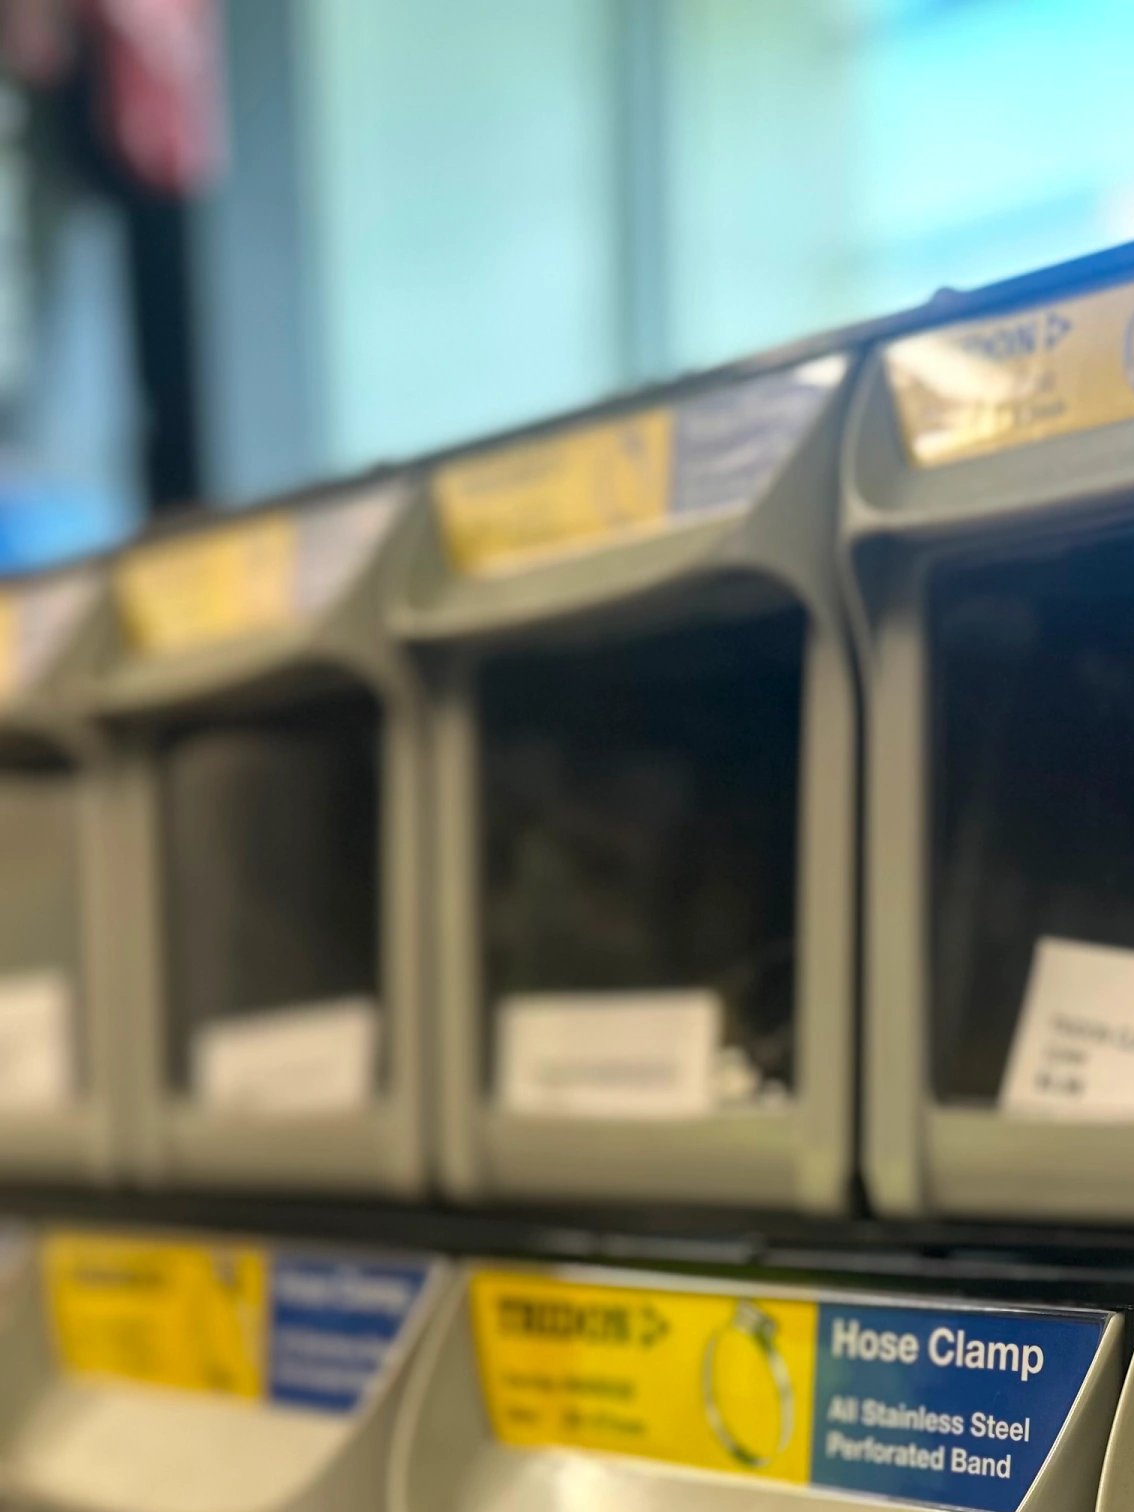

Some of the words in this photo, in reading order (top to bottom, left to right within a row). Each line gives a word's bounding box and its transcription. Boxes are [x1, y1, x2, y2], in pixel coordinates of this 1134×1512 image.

[831, 1317, 919, 1364] Hose
[928, 1327, 1044, 1382] Clamp
[827, 1395, 858, 1424] All
[861, 1398, 964, 1435] Stainless
[970, 1411, 1030, 1442] Steel
[826, 1430, 945, 1471] Perforated
[951, 1447, 1012, 1479] Band
